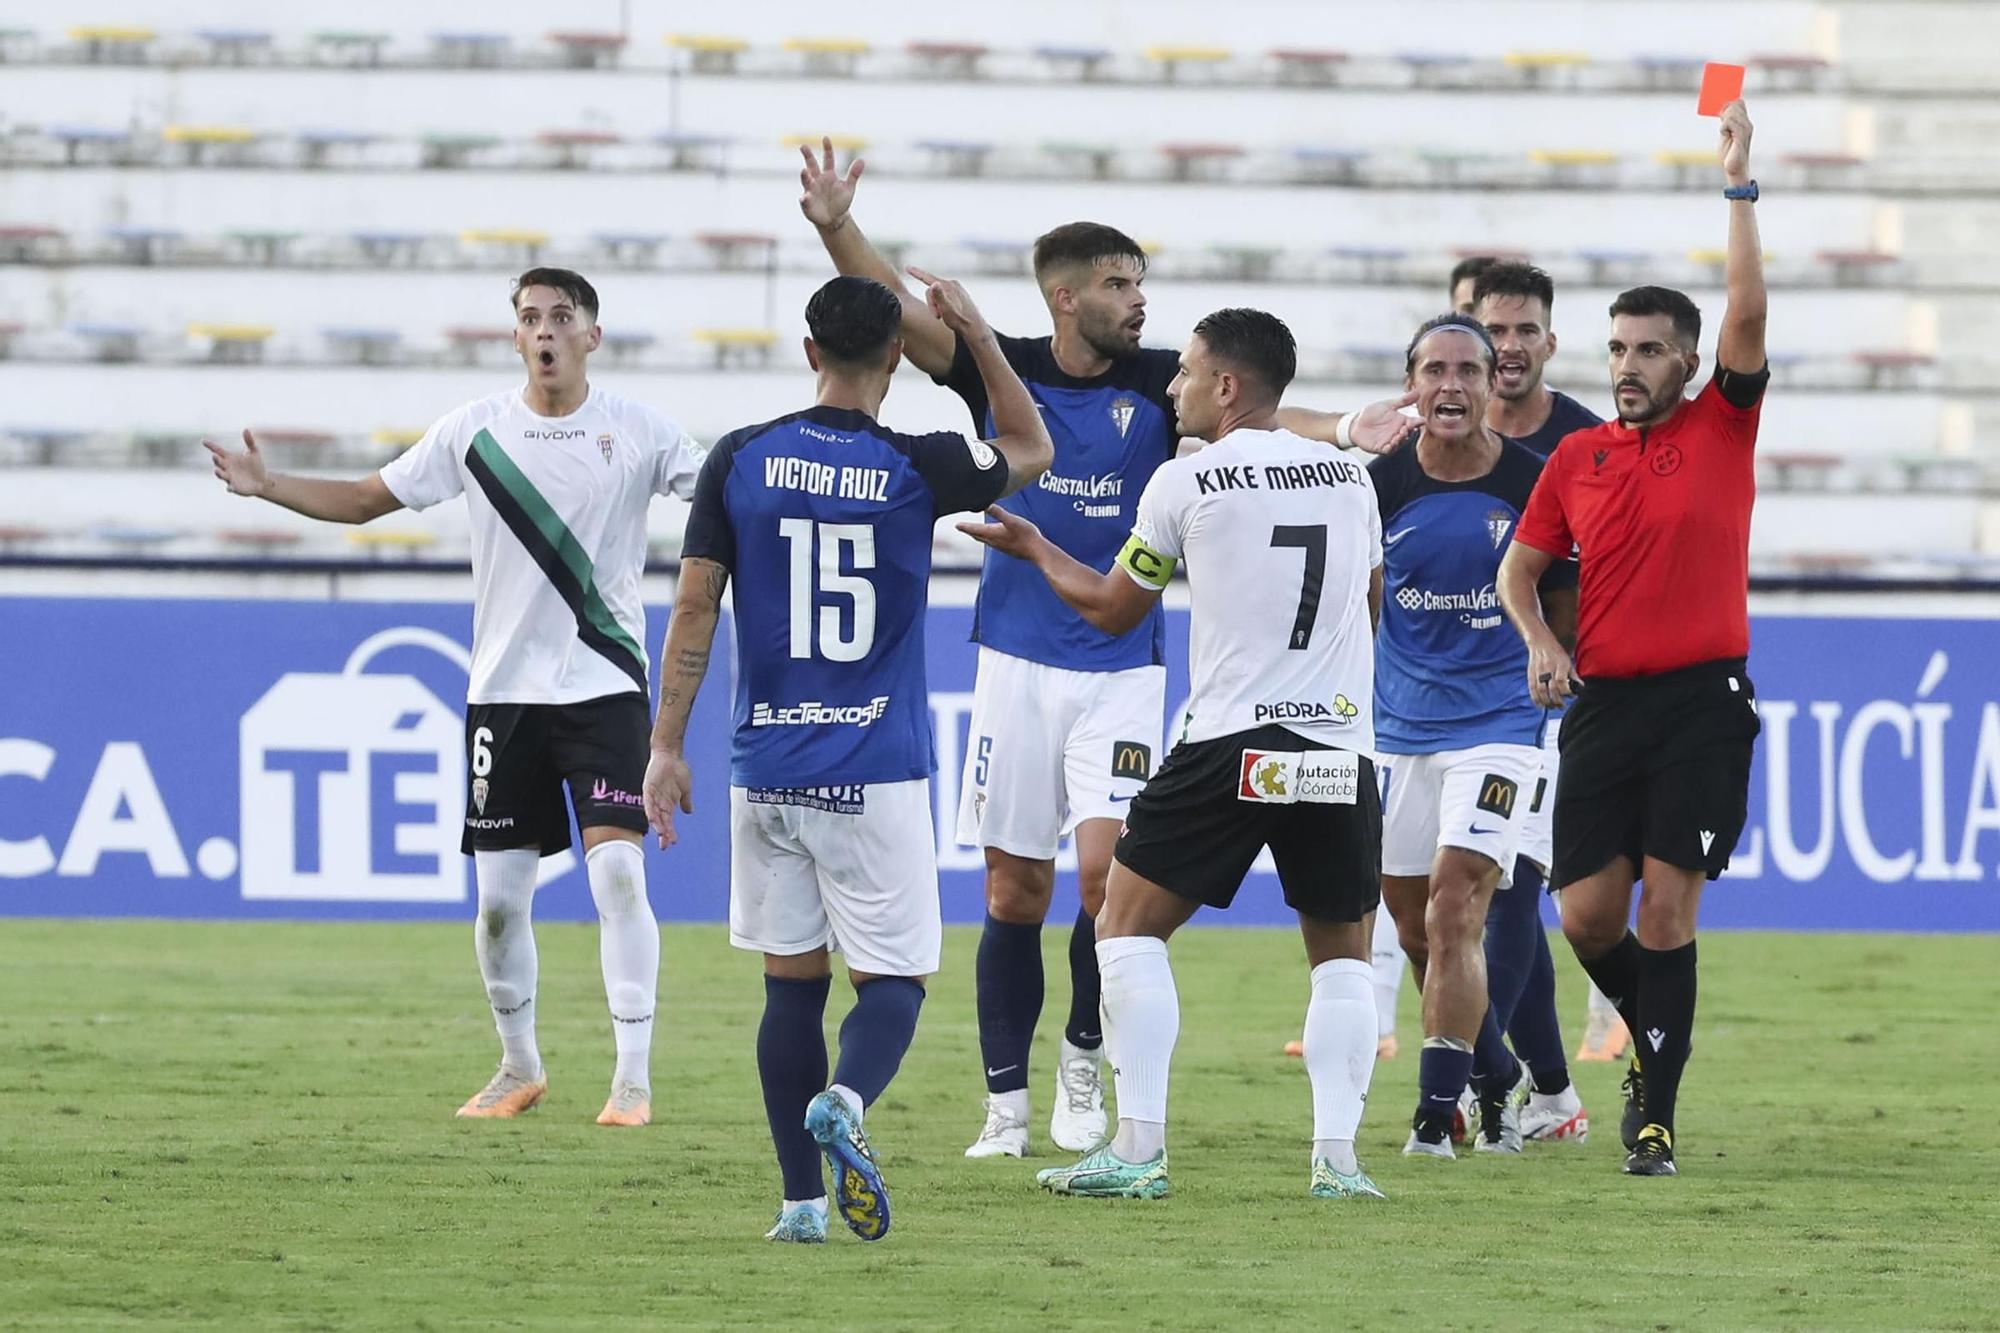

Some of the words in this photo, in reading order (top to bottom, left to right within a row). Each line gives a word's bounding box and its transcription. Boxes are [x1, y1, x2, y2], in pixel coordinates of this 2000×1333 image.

[523, 430, 586, 440] GIVOVA
[764, 456, 836, 497] VICTOR
[838, 466, 889, 502] RUIZ
[1194, 465, 1259, 496] KIKE
[1264, 460, 1367, 490] MÁRQUEZ
[1084, 504, 1121, 517] REHAU
[1129, 547, 1162, 578] C
[778, 517, 876, 662] 15
[1270, 524, 1328, 650] 7
[472, 726, 494, 777] 6
[974, 735, 993, 787] 5
